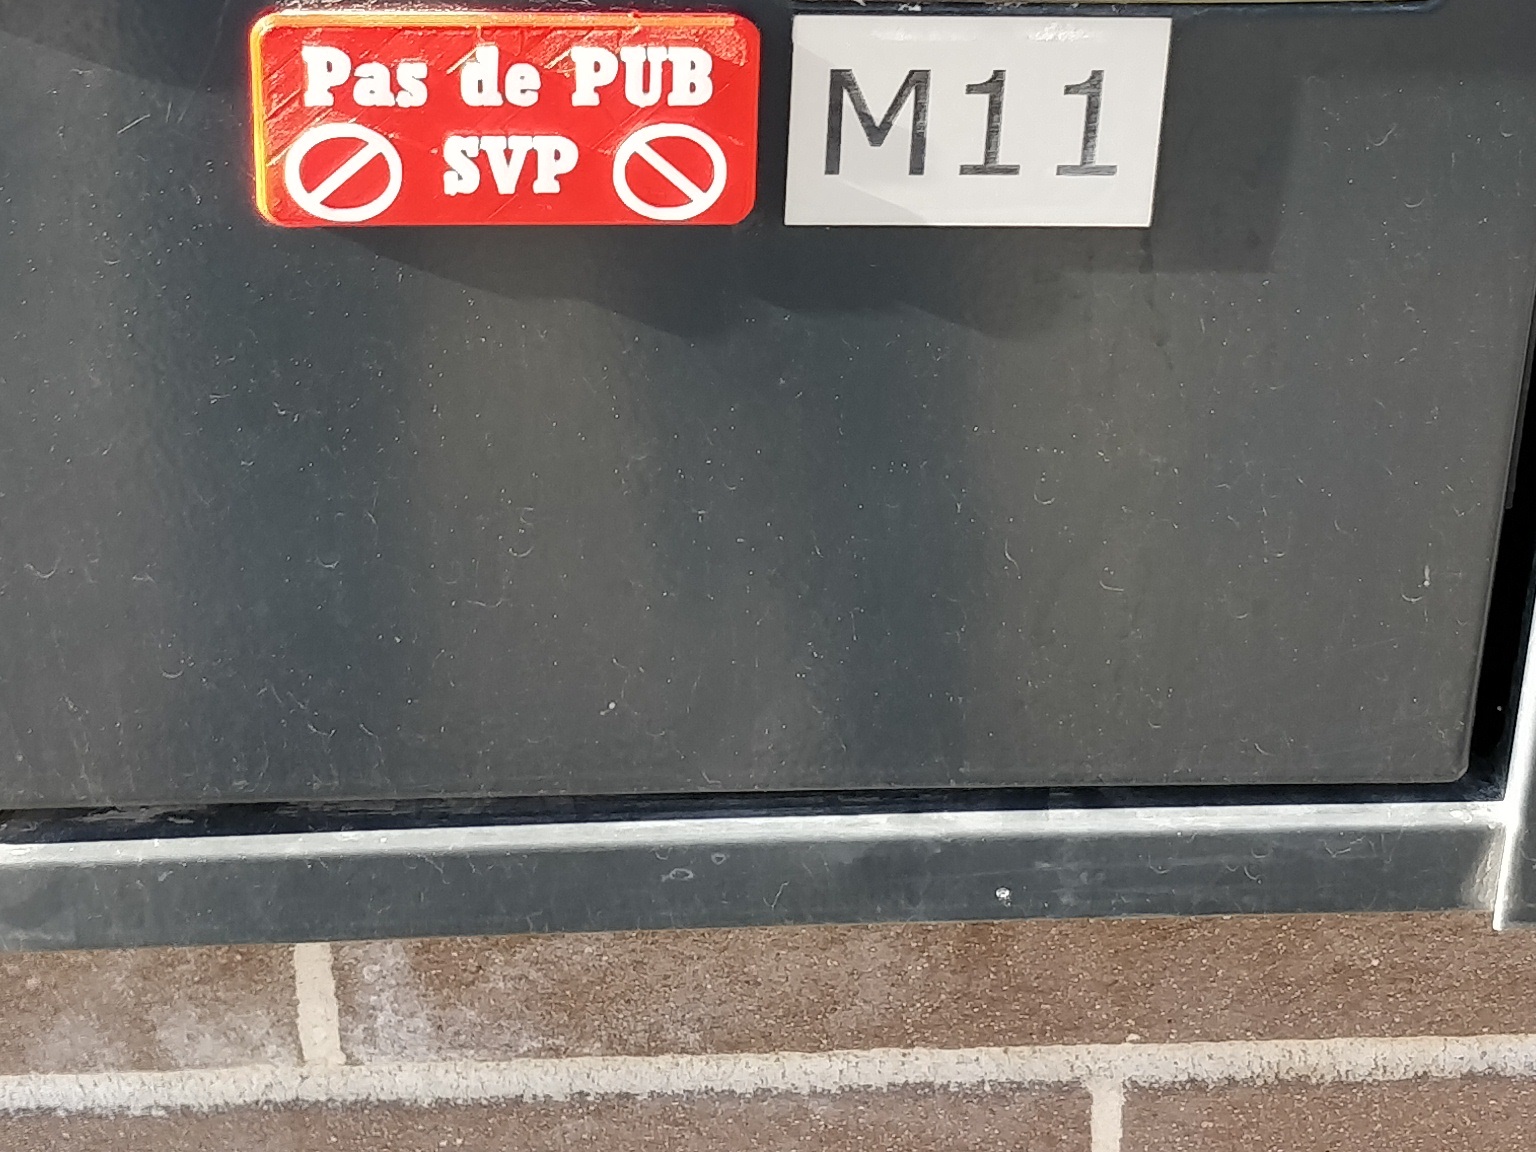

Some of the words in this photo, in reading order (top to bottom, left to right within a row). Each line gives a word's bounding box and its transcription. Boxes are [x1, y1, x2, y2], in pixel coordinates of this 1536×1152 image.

[301, 45, 428, 108] Pas
[462, 44, 542, 108] de
[571, 46, 714, 108] PUB
[823, 68, 1119, 176] M11
[443, 134, 580, 196] SVP
